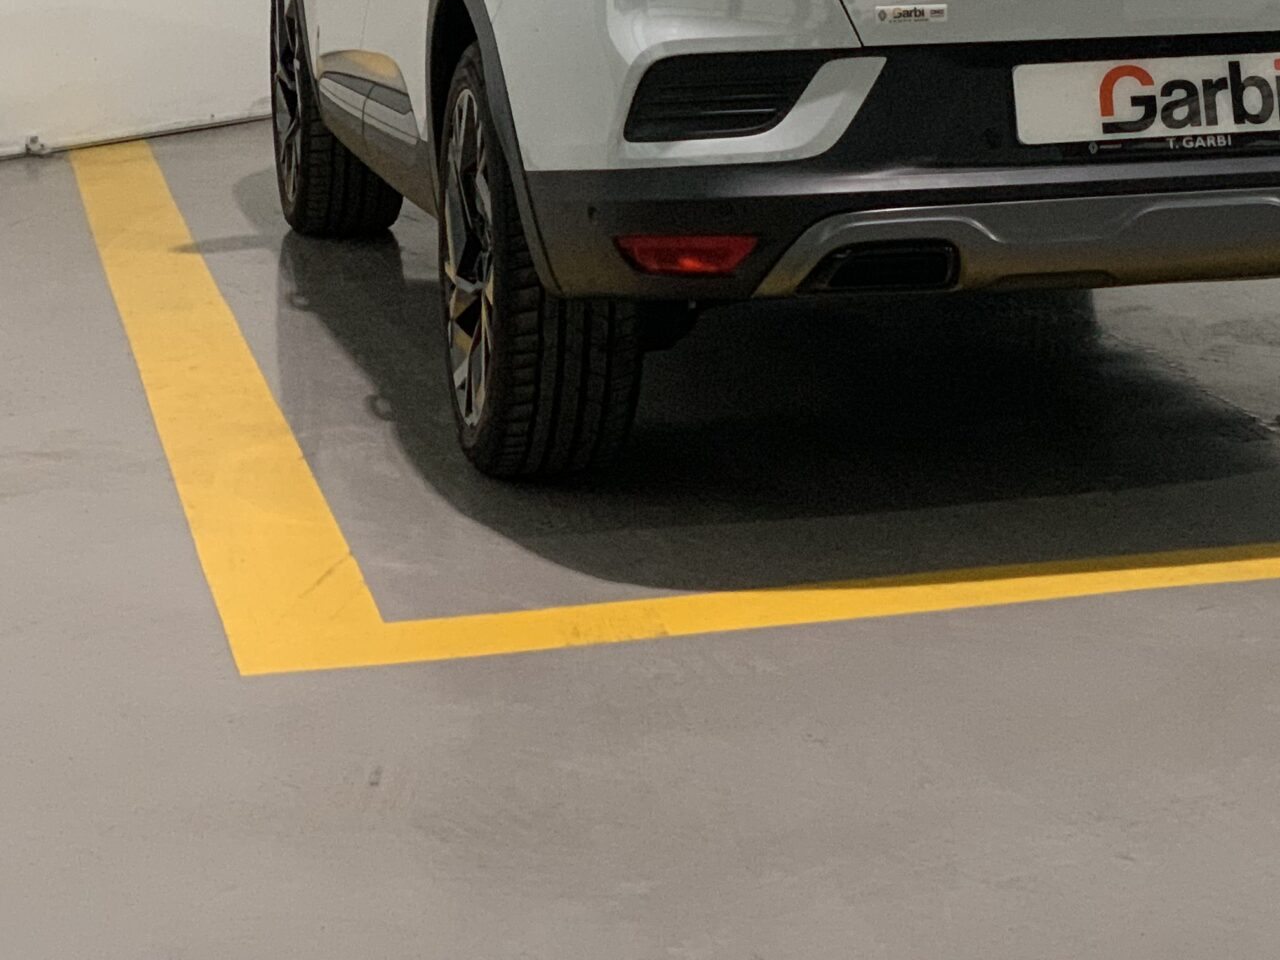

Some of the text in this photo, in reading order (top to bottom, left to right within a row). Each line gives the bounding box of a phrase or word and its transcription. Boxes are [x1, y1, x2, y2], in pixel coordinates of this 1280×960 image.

[893, 7, 925, 19] Garbi
[1167, 135, 1232, 150] T. GARBI
